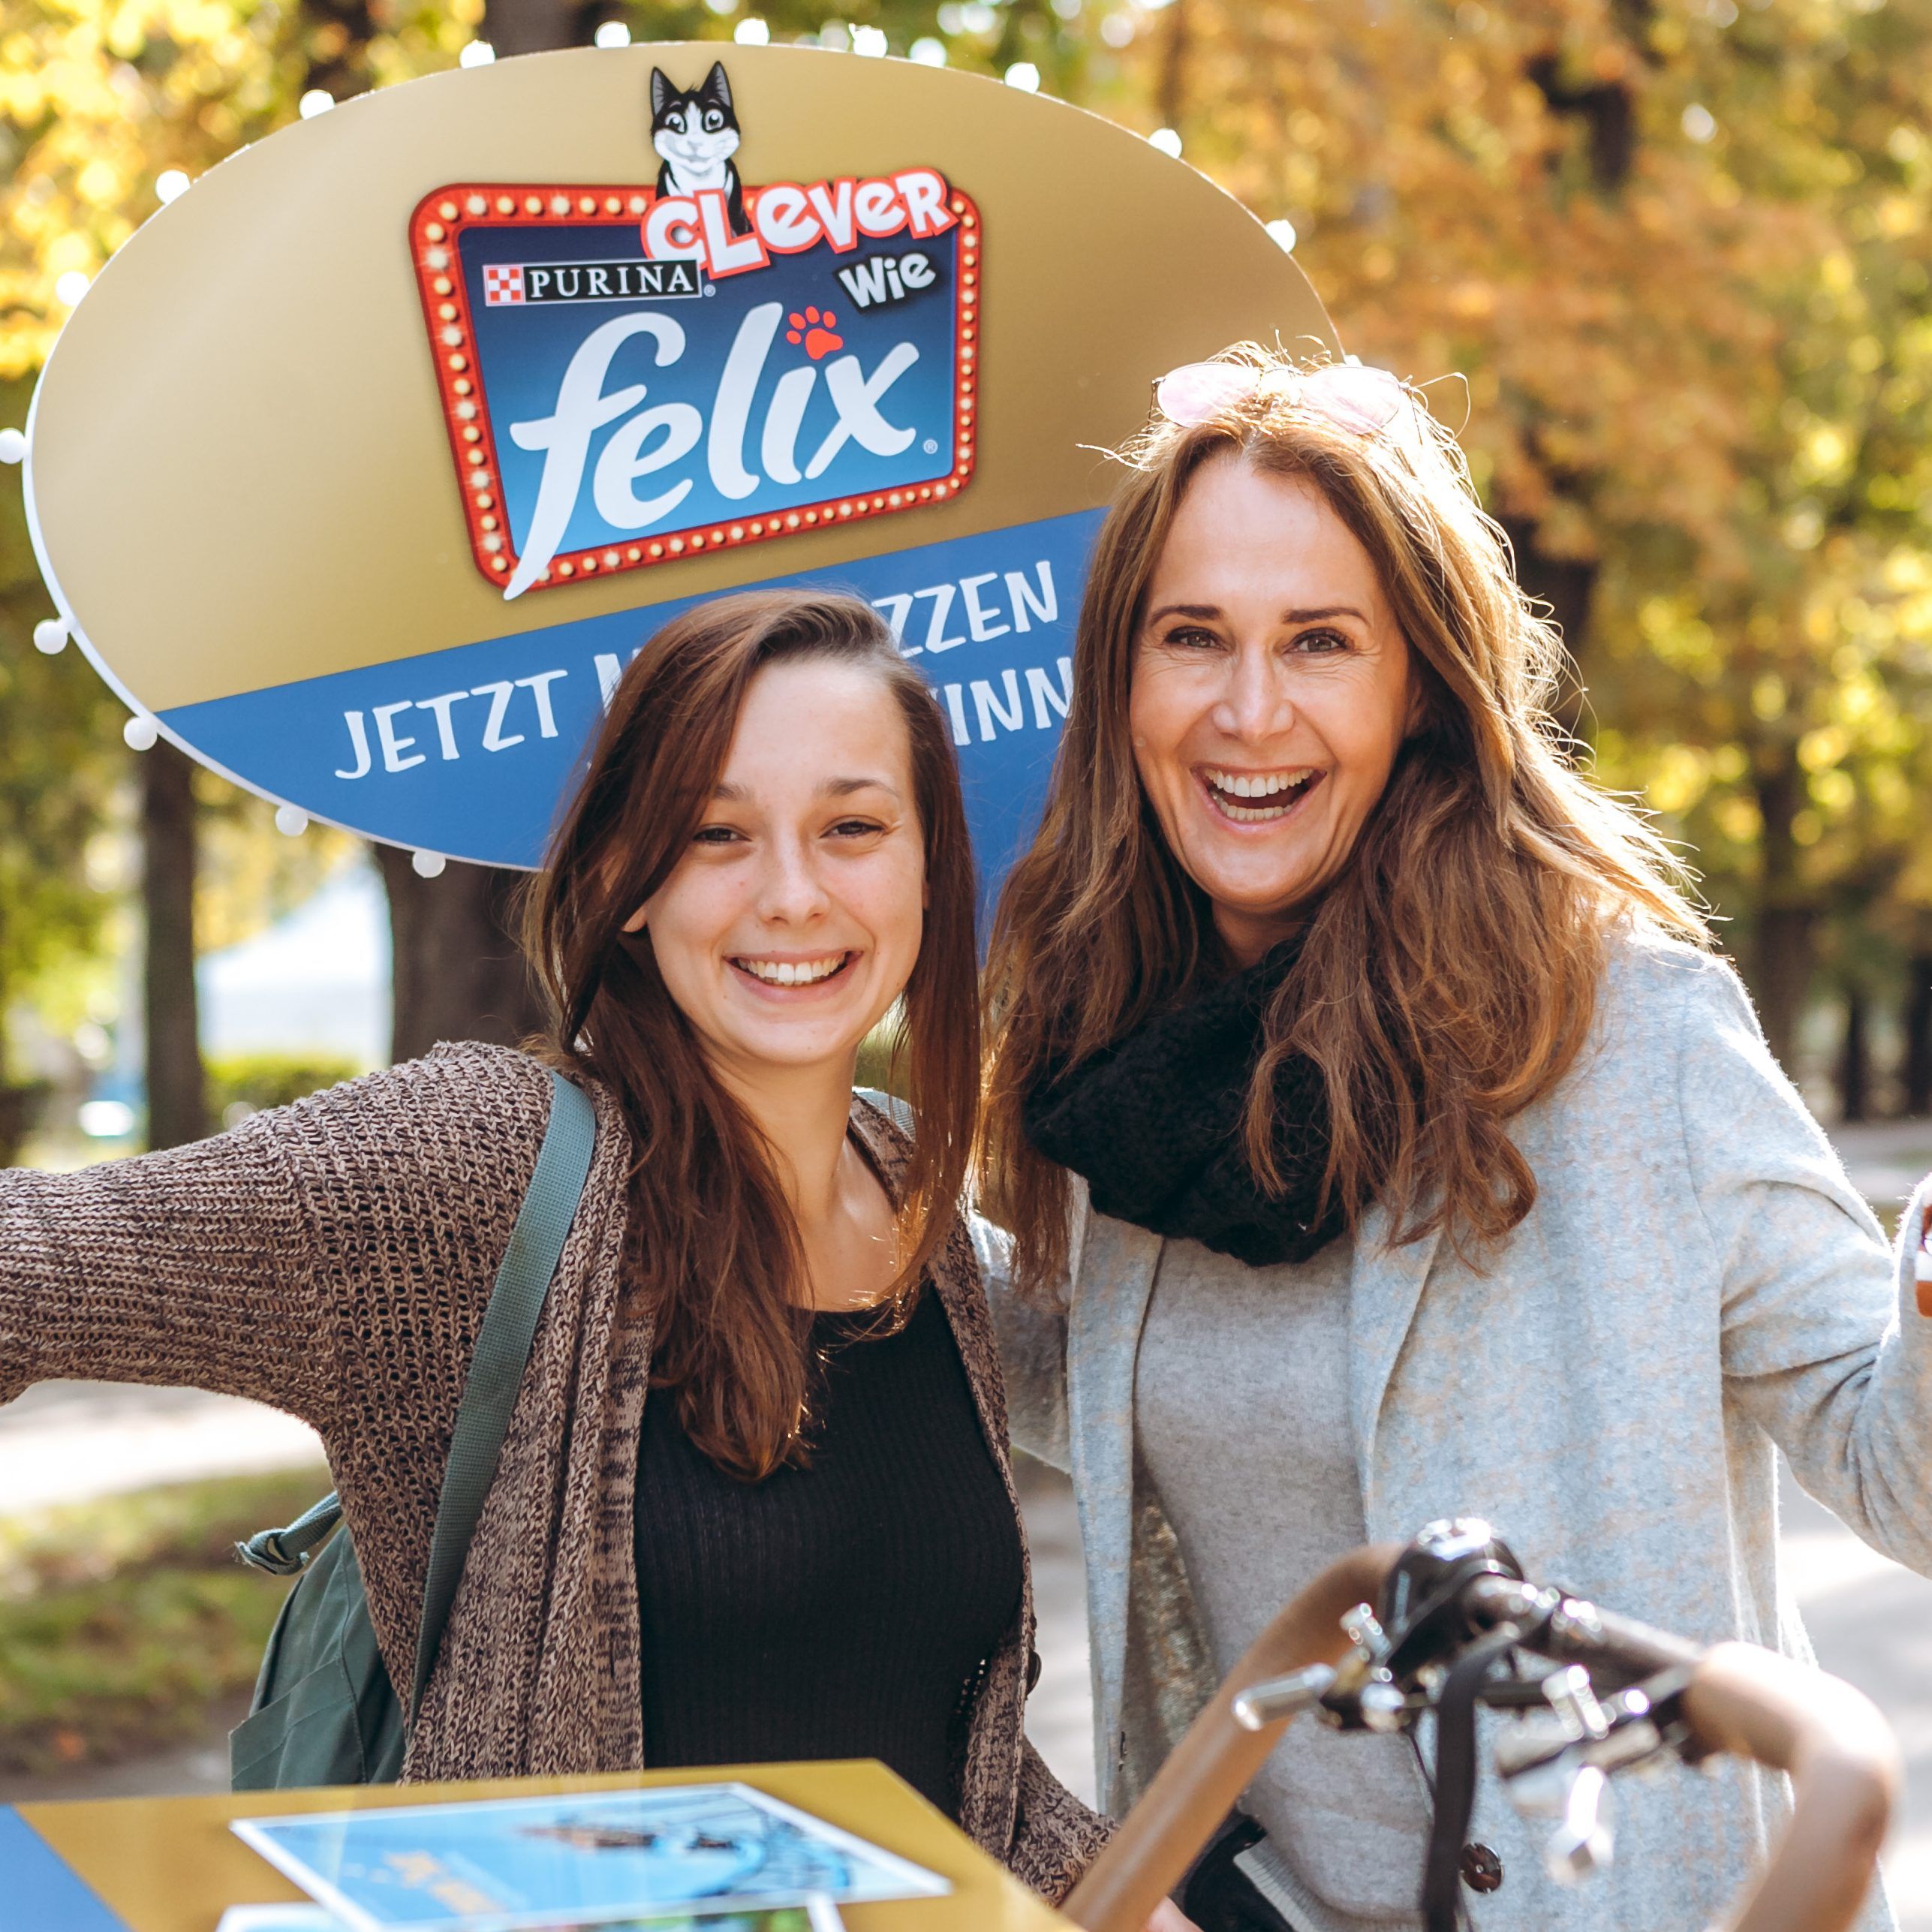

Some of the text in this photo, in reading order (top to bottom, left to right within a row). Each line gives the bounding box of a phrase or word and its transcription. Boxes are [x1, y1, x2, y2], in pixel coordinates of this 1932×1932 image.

[529, 264, 694, 298] PURINA
[502, 302, 920, 600] felix
[335, 670, 568, 779] JETZT
[871, 560, 1058, 658] ZZEN
[925, 657, 1075, 746] INN
